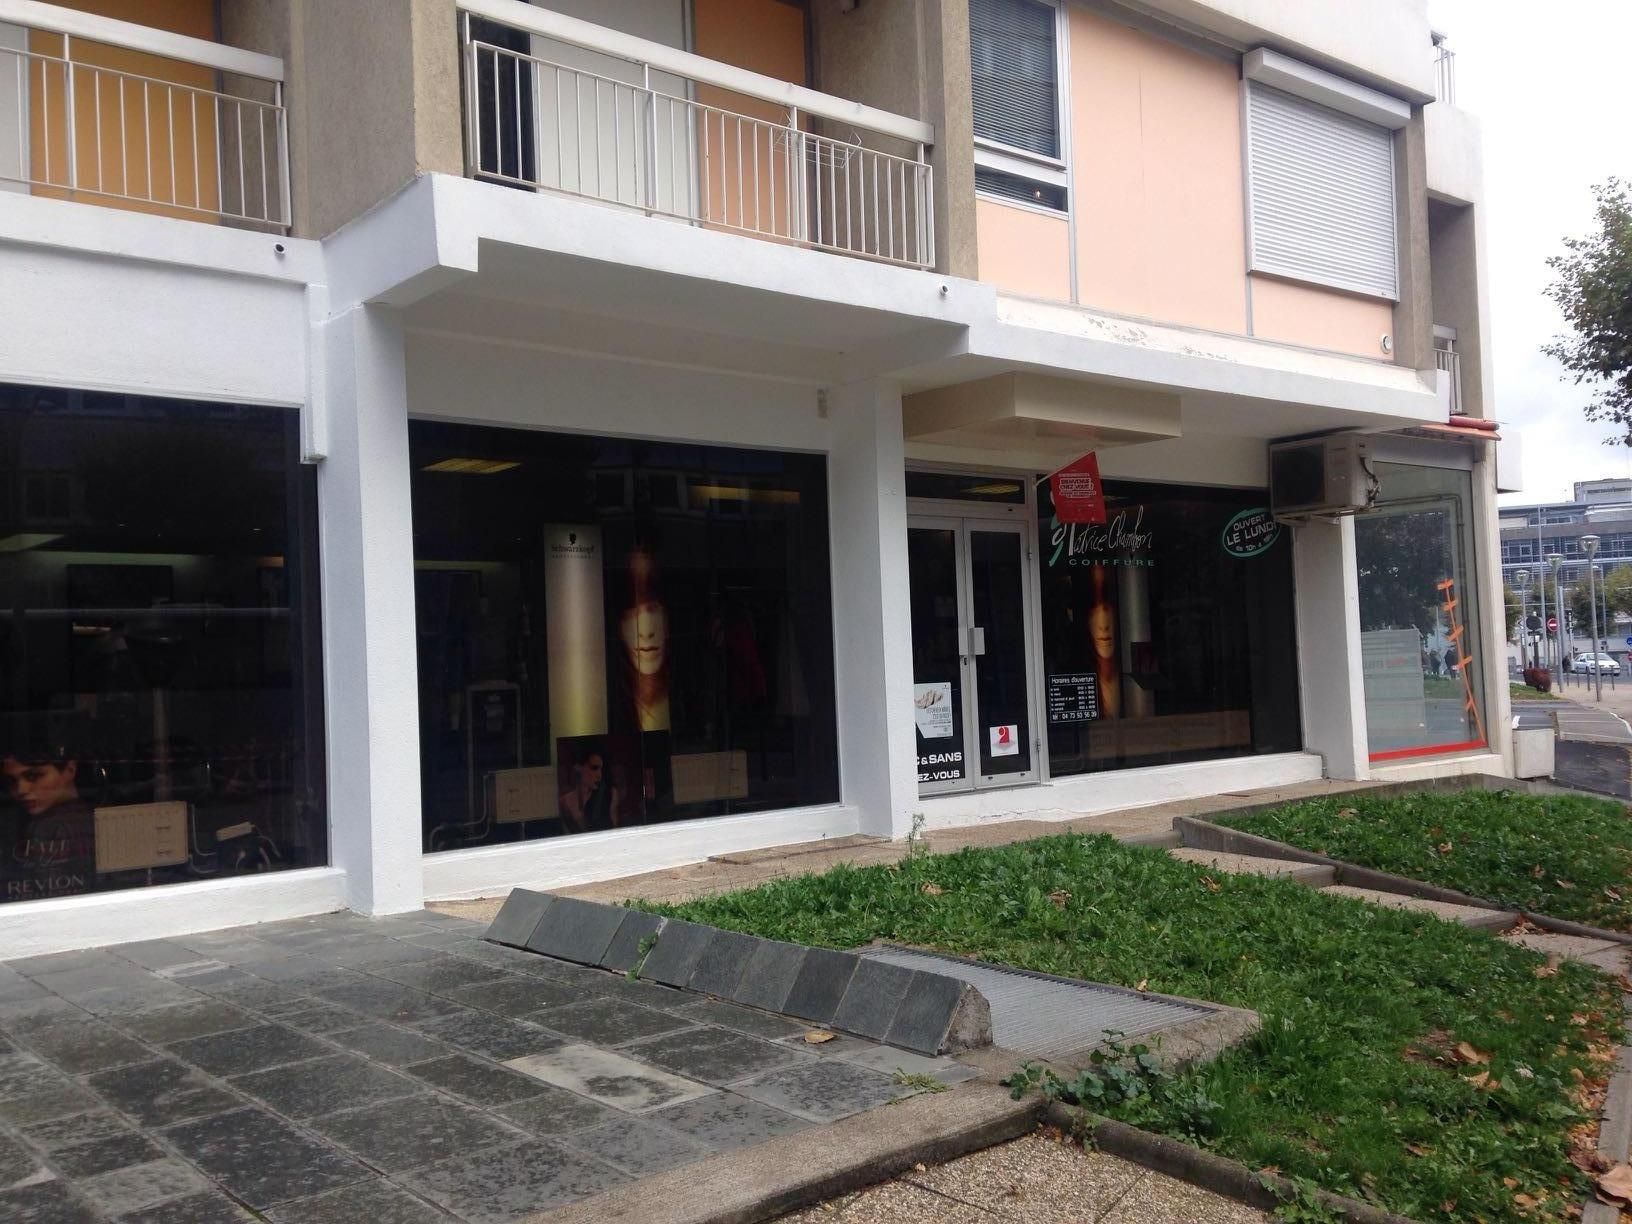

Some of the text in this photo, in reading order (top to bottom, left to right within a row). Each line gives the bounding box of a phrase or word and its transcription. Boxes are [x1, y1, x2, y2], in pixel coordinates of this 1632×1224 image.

[1226, 532, 1241, 546] LE
[1068, 559, 1155, 567] COIFFURE
[928, 751, 963, 764] SANS
[7, 874, 85, 895] REVLON
